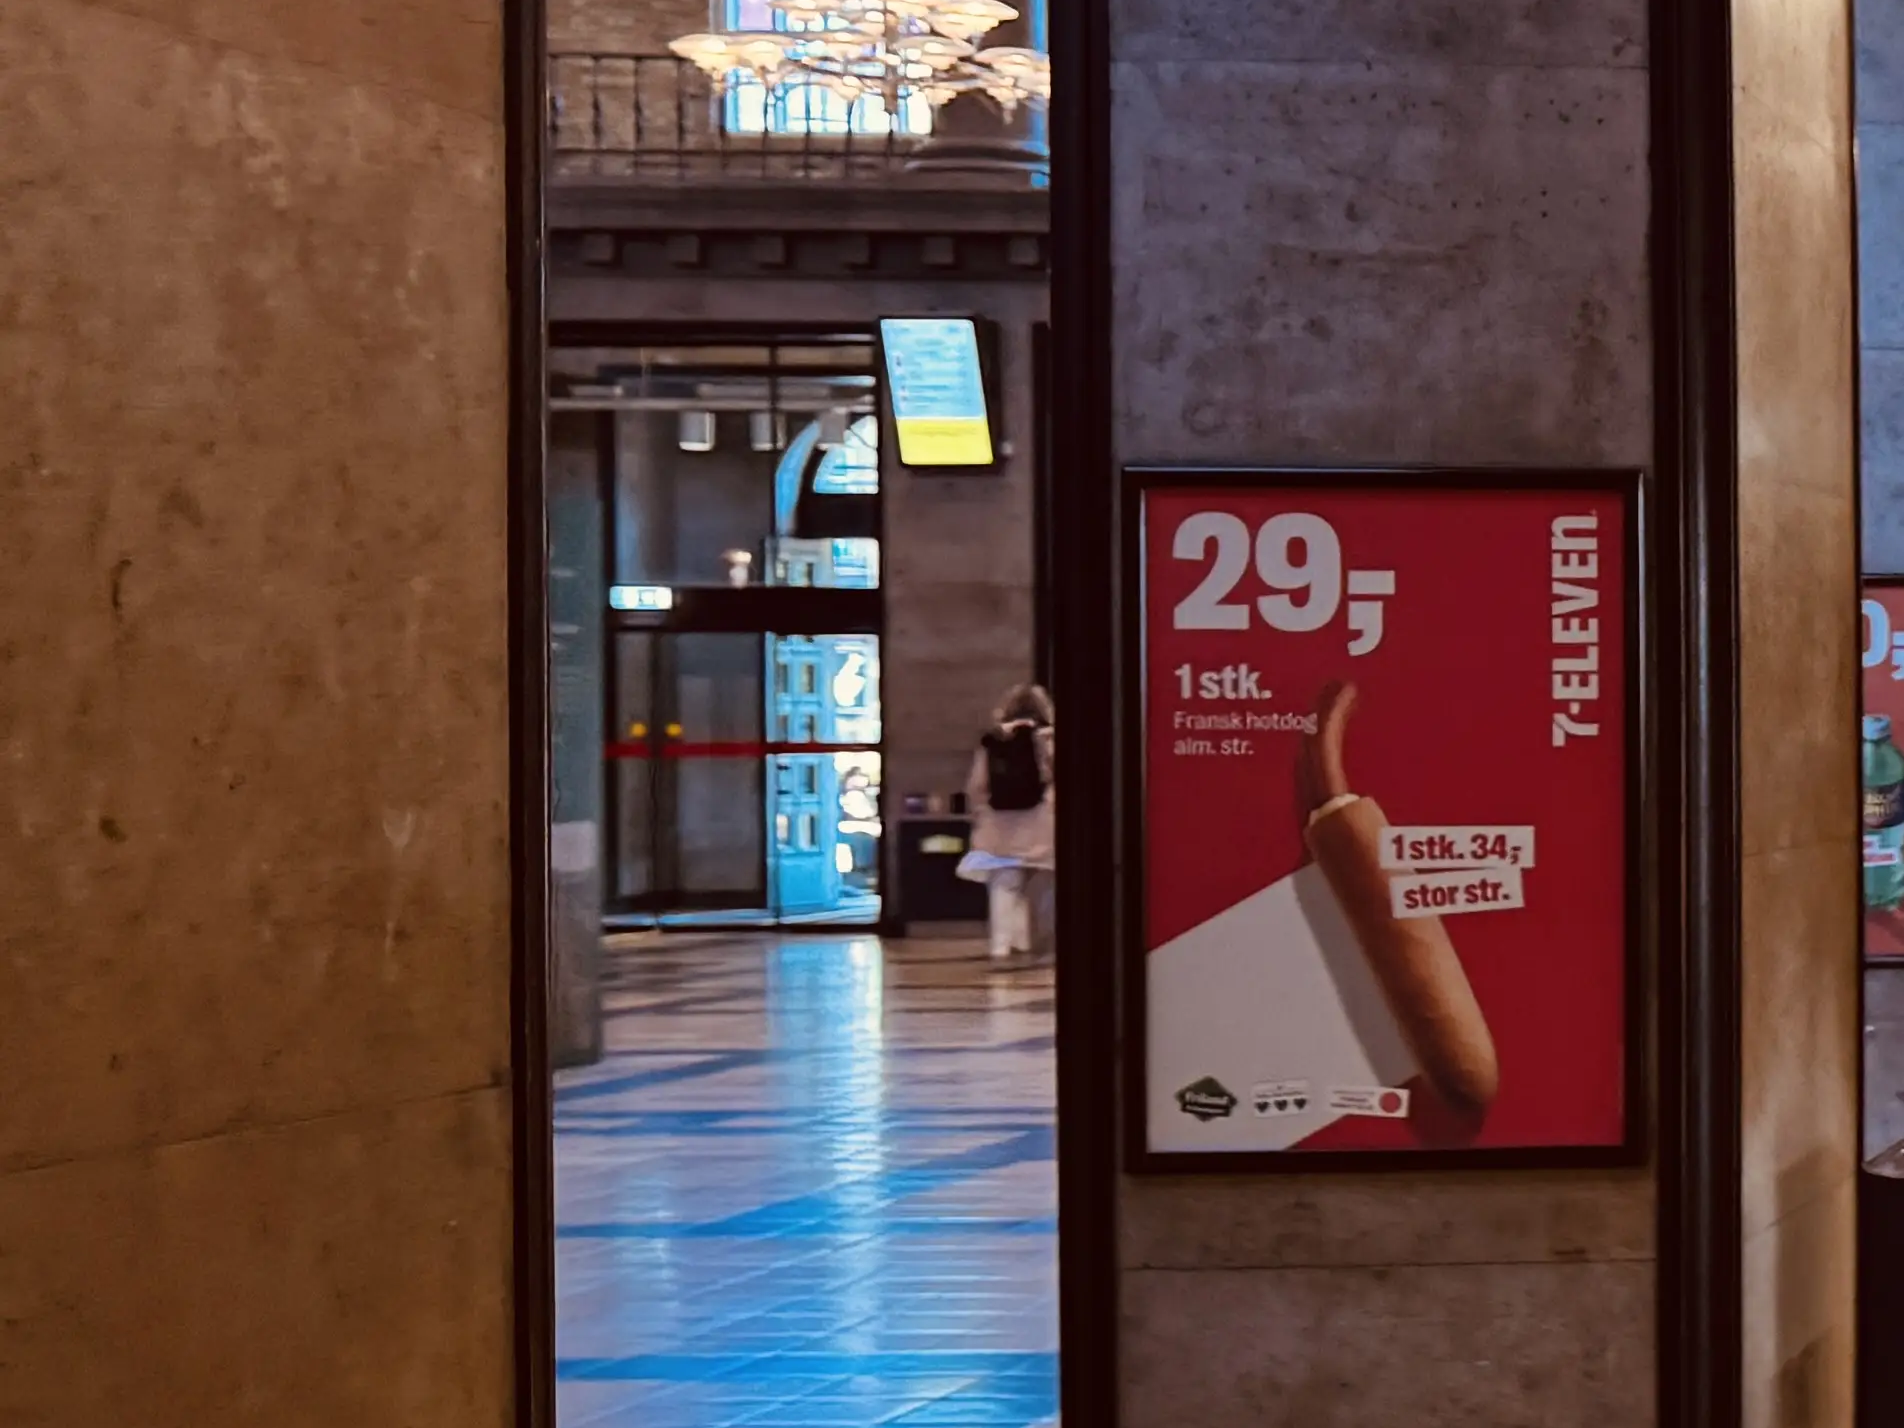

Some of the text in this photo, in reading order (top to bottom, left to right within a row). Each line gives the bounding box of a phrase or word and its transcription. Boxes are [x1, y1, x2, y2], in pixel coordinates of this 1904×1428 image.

[1173, 710, 1318, 735] Fransk hotdog
[1173, 737, 1255, 756] alm. str.
[1403, 878, 1512, 910] stor str.
